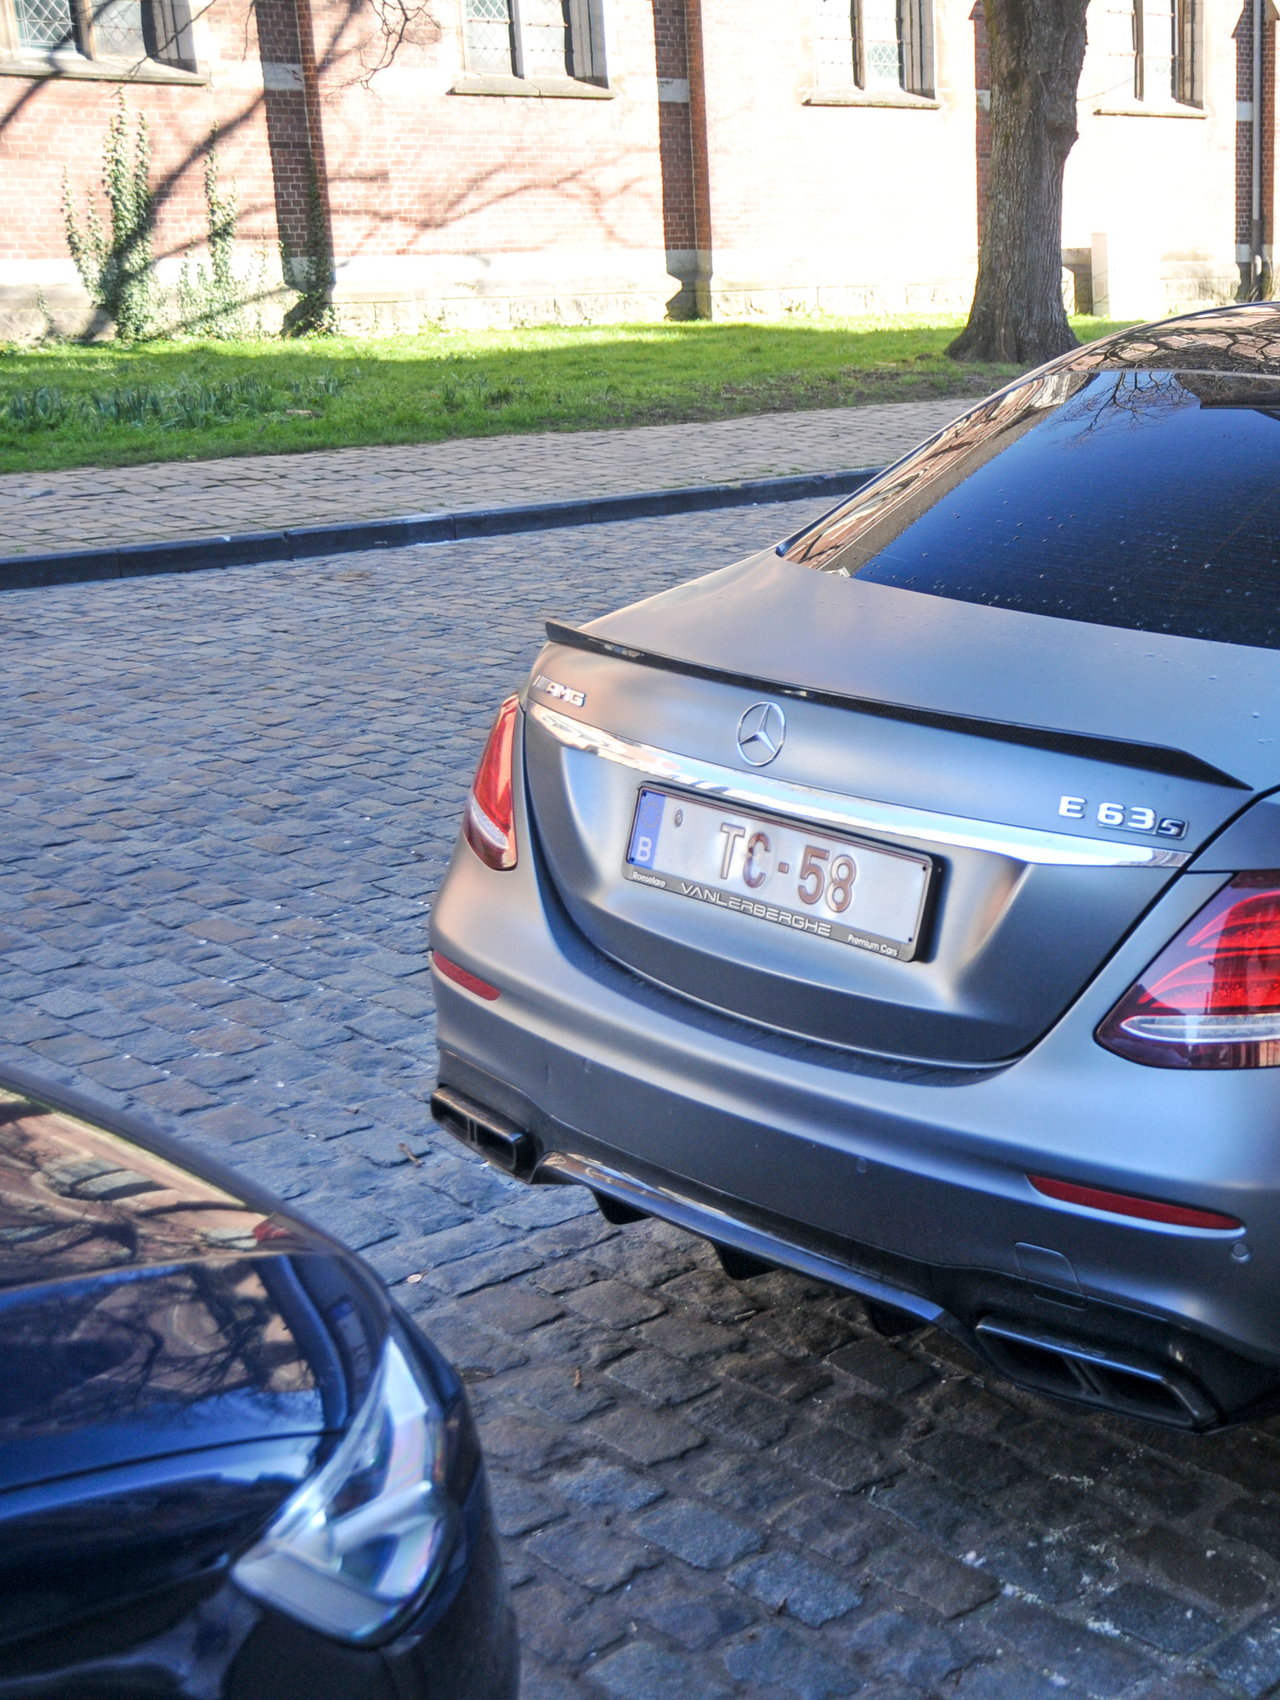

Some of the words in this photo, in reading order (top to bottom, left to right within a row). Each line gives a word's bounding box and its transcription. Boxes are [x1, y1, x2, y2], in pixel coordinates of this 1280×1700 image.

[546, 681, 586, 707] AMG
[1058, 795, 1087, 819] E
[635, 836, 653, 862] B
[632, 871, 667, 888] Roeselare
[720, 822, 857, 914] TC-58
[680, 882, 832, 937] VANLERBERGHE
[848, 934, 880, 951] Premium
[880, 943, 898, 957] Cars
